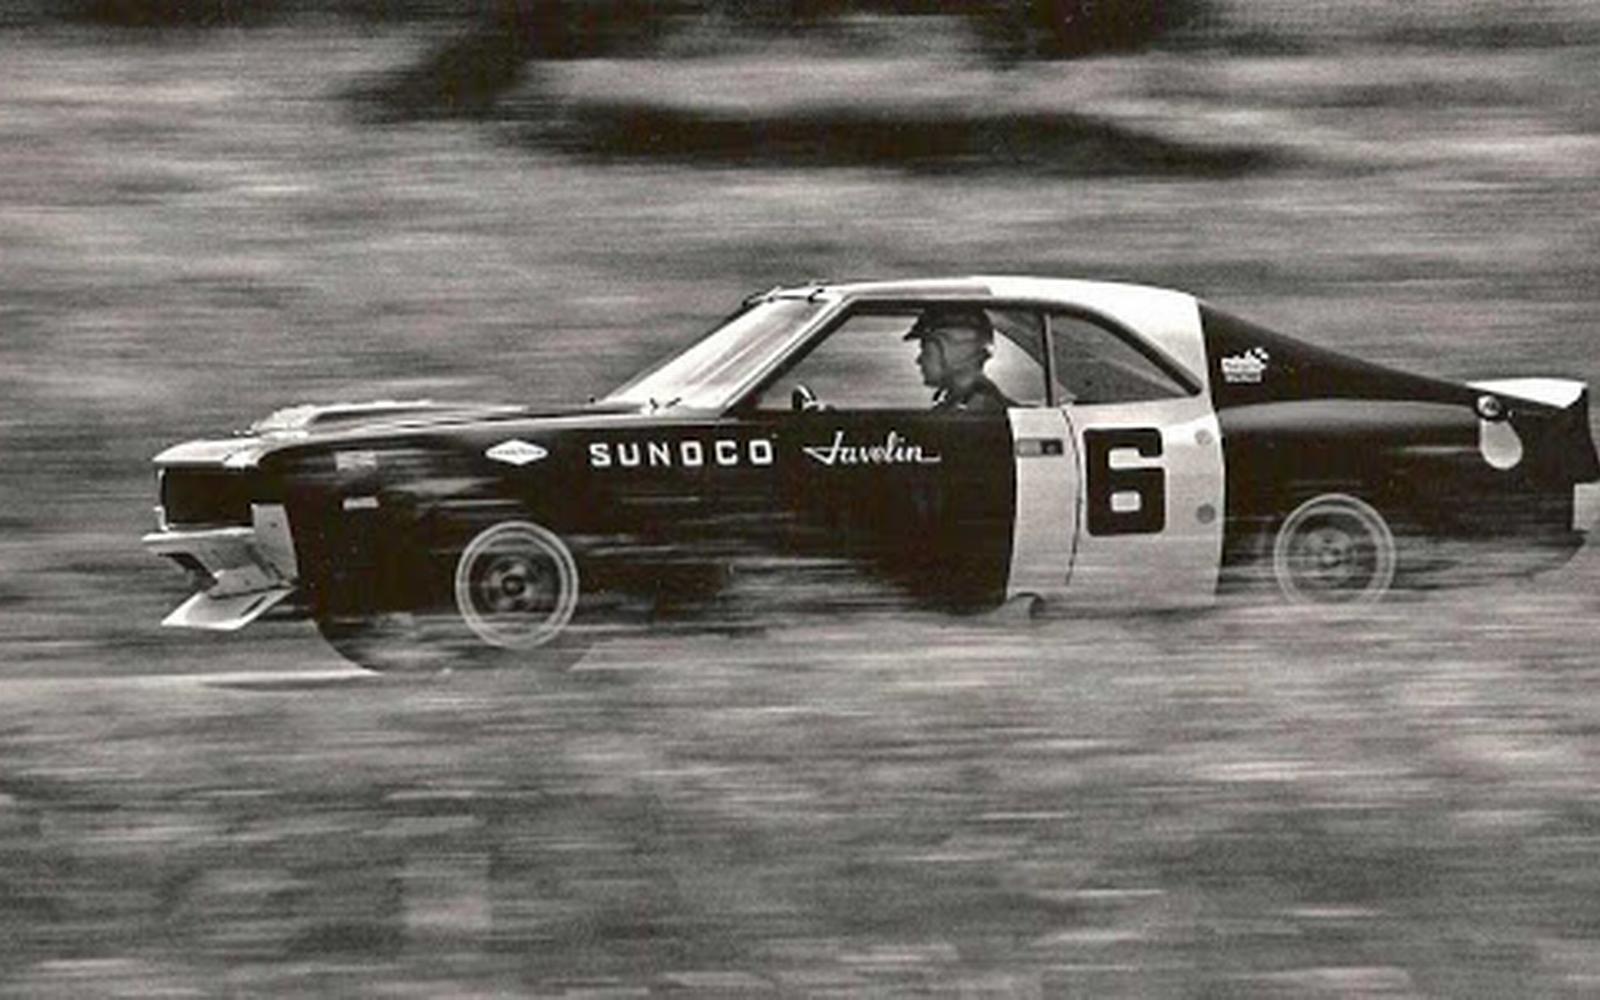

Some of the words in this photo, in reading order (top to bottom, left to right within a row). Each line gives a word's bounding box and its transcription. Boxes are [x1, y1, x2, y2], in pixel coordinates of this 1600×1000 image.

[589, 439, 773, 467] SUNOCO
[802, 431, 941, 465] Javelin
[1083, 427, 1166, 536] 6
